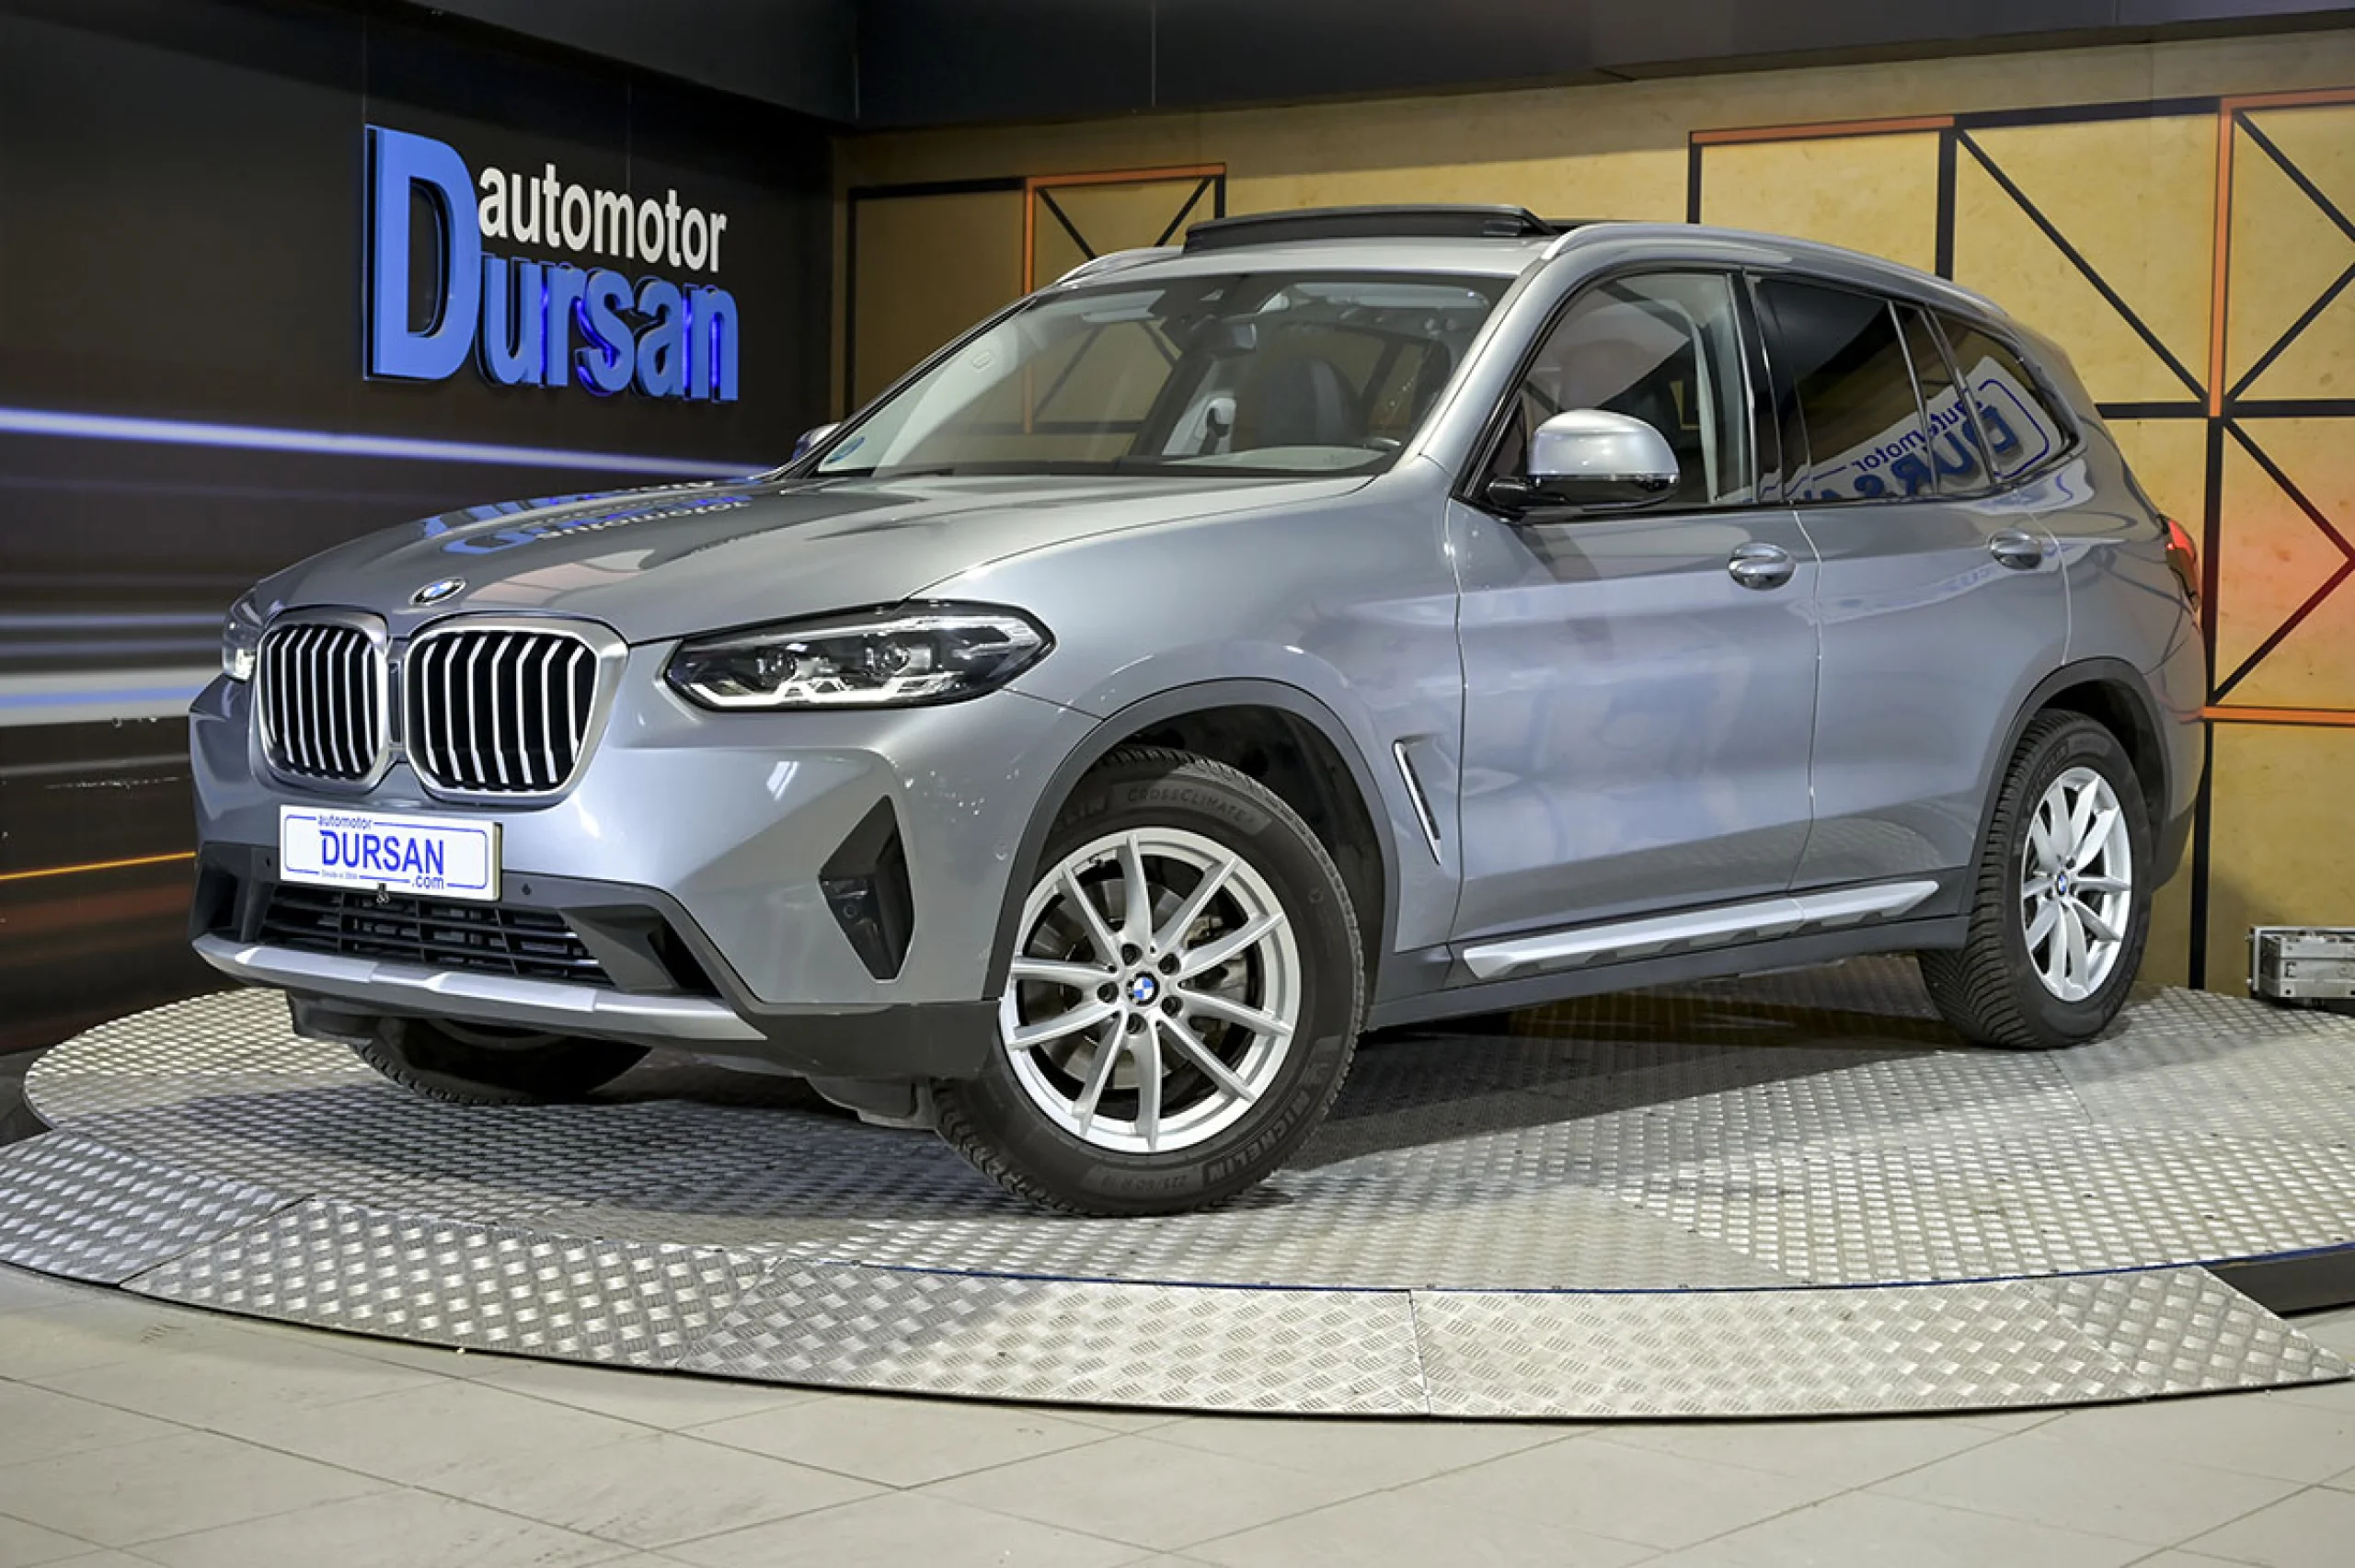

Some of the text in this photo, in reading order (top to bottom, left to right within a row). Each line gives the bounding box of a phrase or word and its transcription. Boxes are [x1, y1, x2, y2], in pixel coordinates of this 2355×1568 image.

[478, 163, 728, 272] automotor
[317, 814, 373, 830] automotor
[319, 830, 444, 876] DURSAN
[1208, 1090, 1310, 1184] MICHELIN
